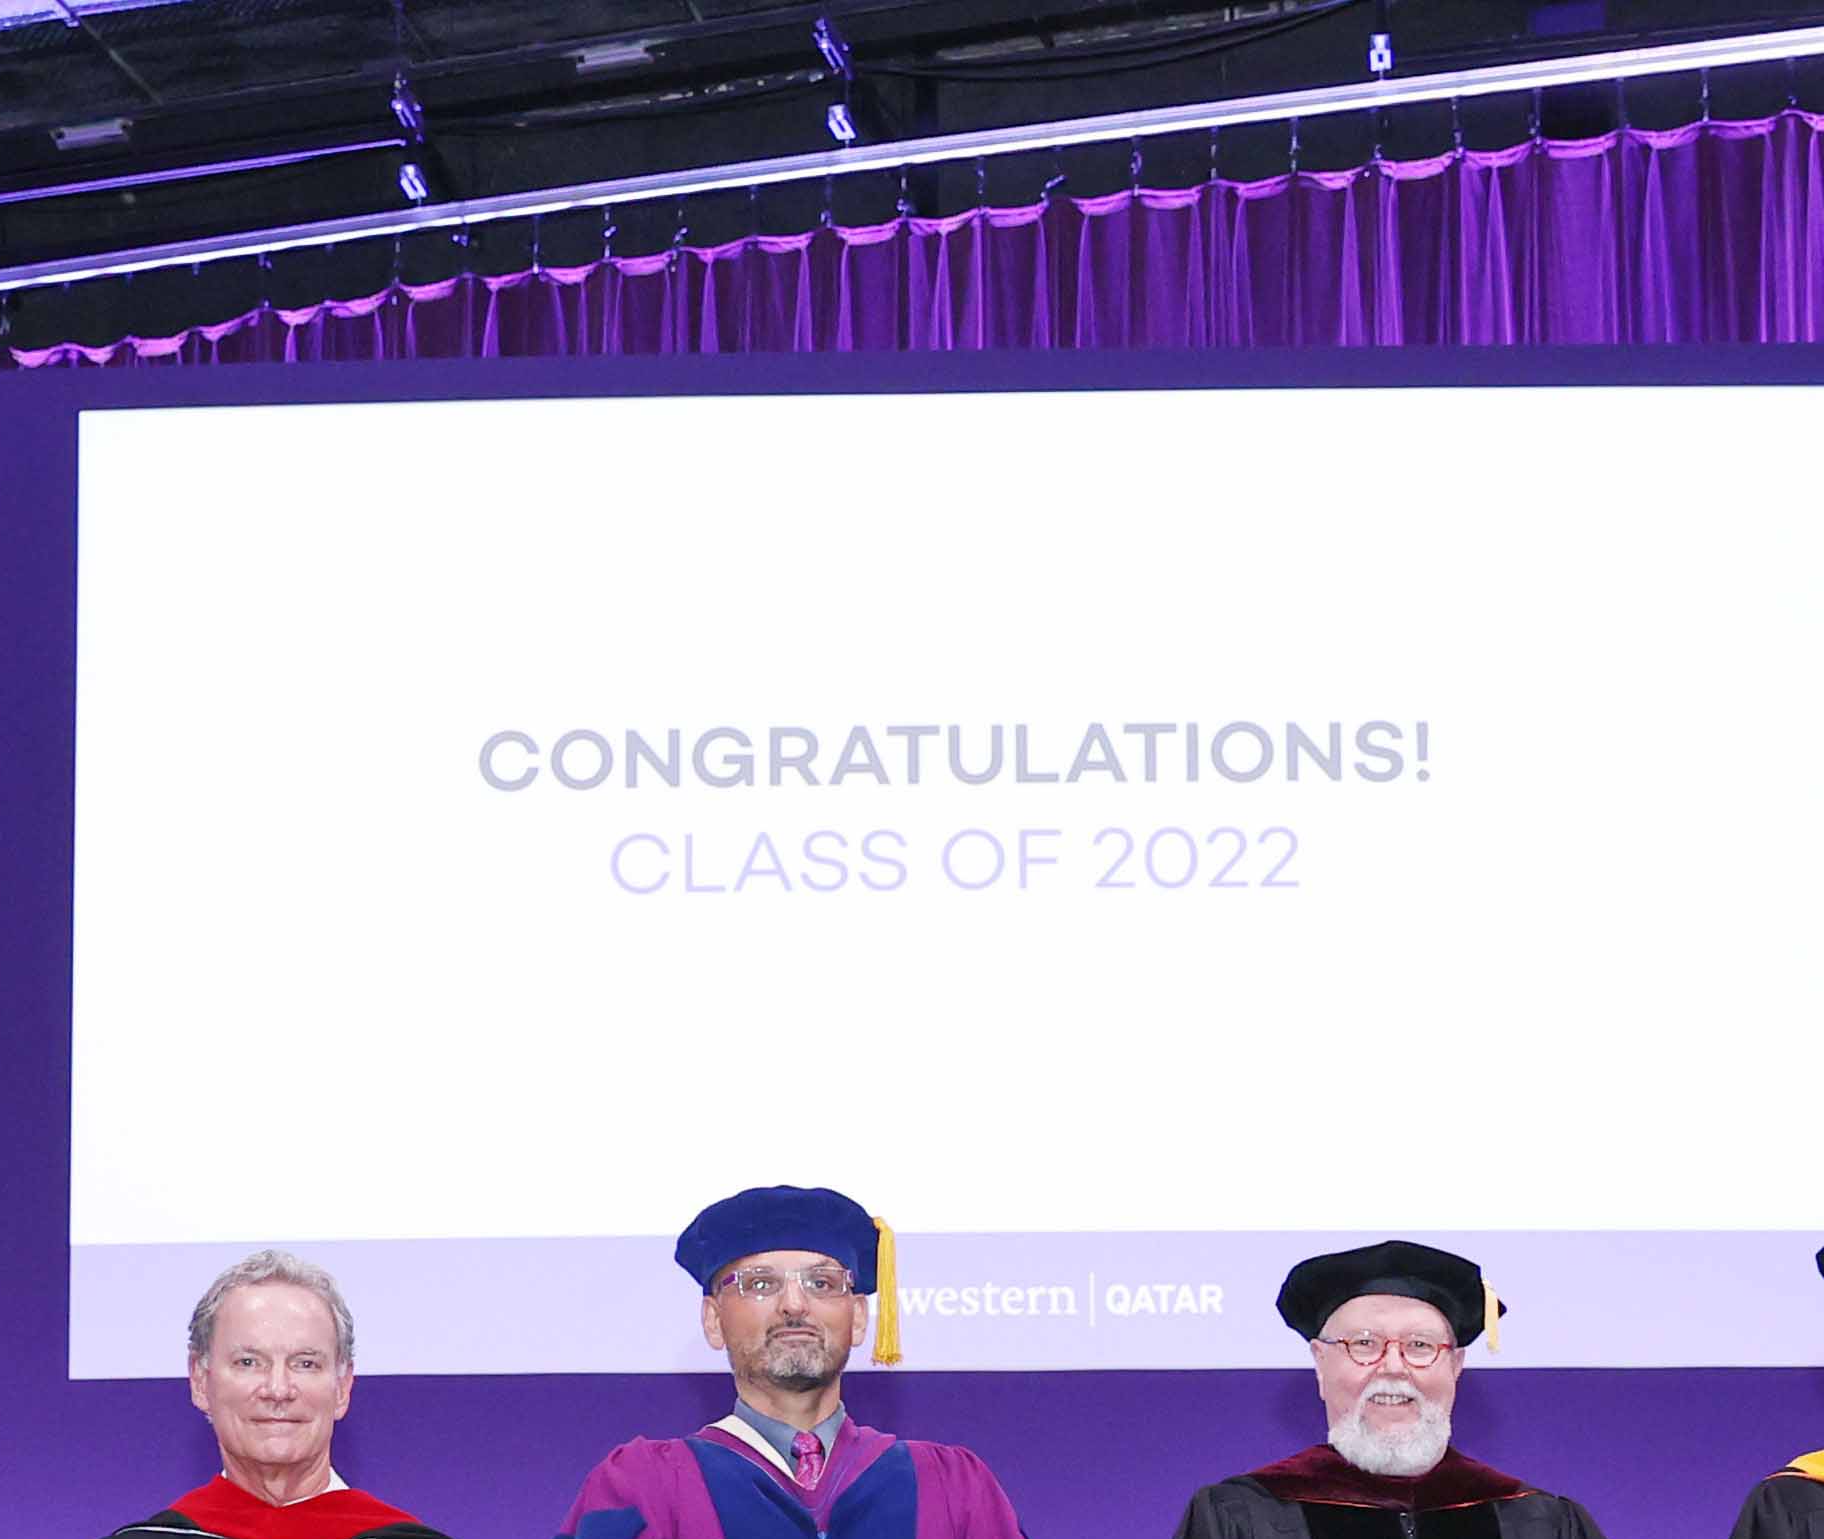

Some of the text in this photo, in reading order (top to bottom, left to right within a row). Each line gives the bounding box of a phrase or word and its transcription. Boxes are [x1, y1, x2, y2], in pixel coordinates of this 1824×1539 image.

[478, 719, 1431, 793] CONGRATULATIONS!
[608, 825, 1301, 896] CLASS OF 2022
[1105, 1284, 1224, 1317] QATAR
